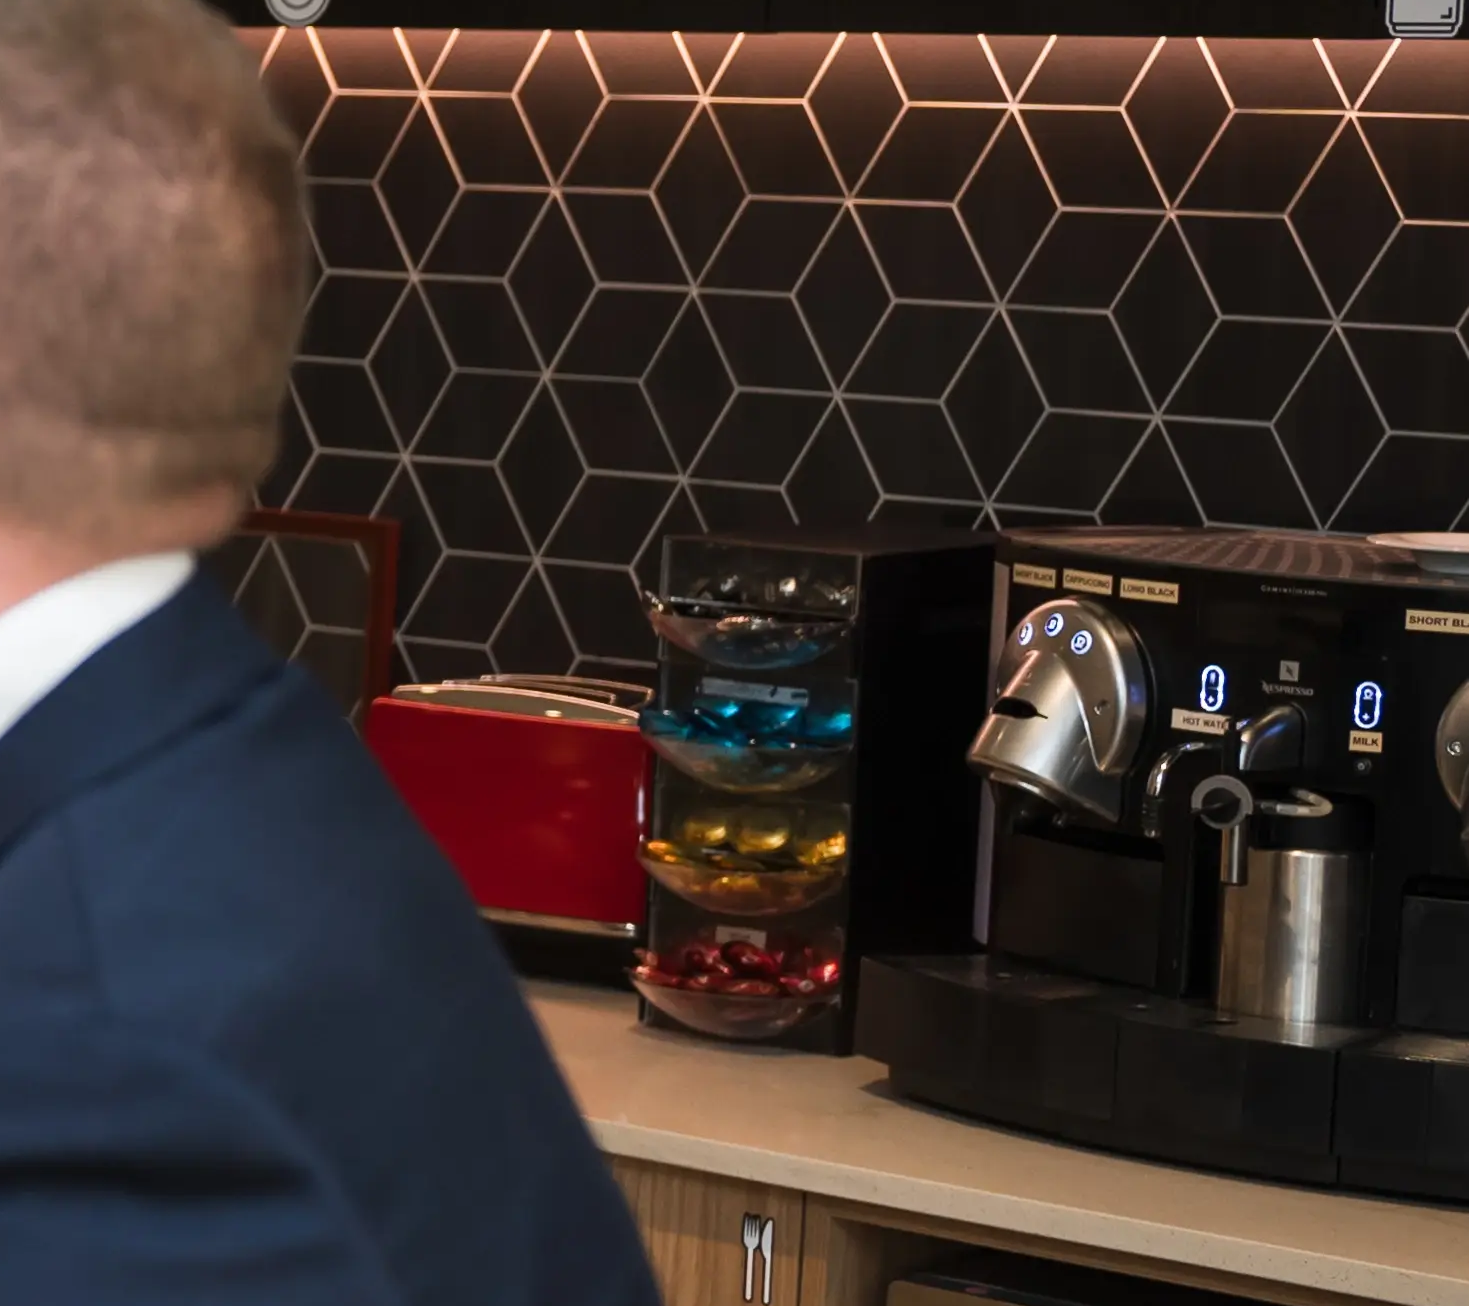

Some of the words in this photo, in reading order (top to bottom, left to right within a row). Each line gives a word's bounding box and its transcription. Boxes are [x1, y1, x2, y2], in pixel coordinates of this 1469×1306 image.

[1065, 573, 1110, 590] CAPPUCCINO
[1122, 583, 1145, 594] LONG
[1147, 586, 1175, 598] BLACK
[1408, 615, 1449, 627] SHORT
[1260, 680, 1314, 696] NESPRESSO
[1182, 715, 1200, 726] HOT
[1352, 736, 1379, 747] MILK
